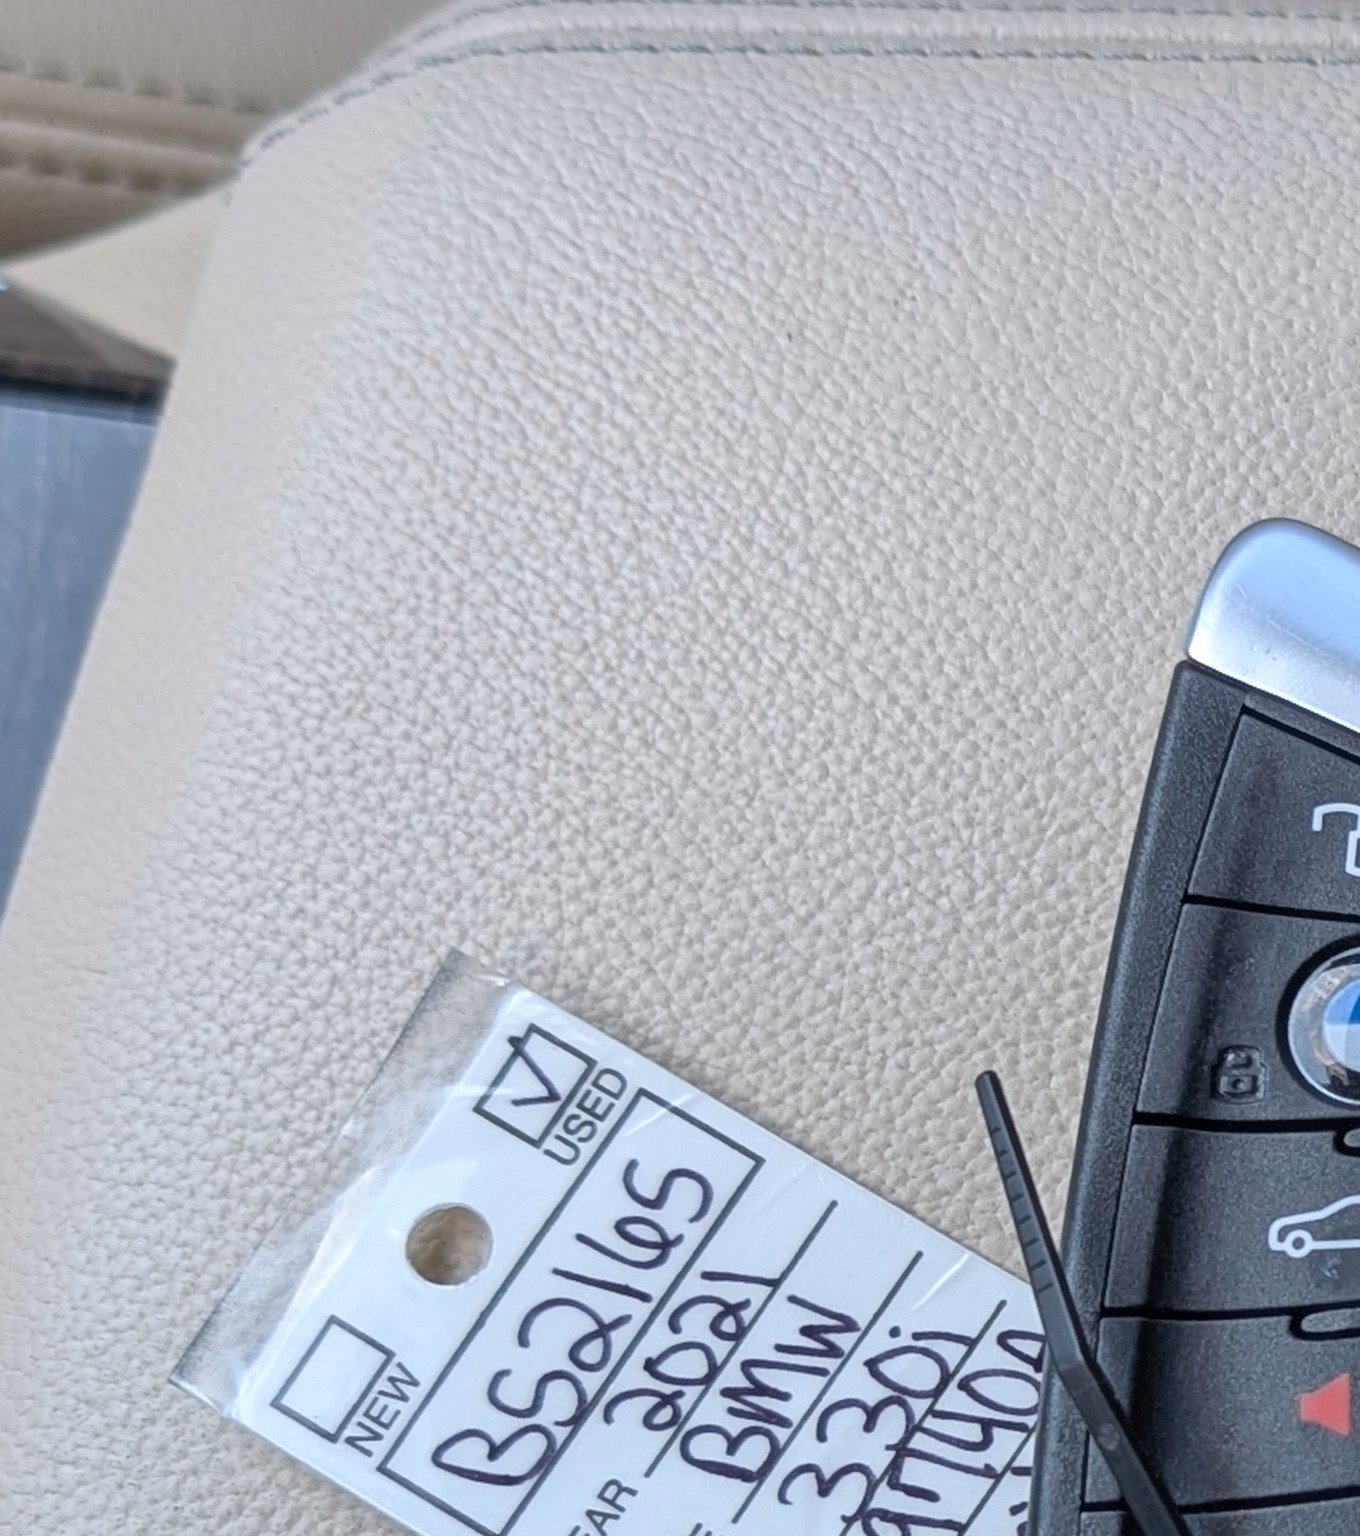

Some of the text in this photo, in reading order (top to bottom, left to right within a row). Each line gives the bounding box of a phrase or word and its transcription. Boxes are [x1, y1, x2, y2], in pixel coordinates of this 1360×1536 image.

[544, 1067, 628, 1167] USED
[345, 1361, 421, 1459] NEW
[603, 1270, 780, 1432] 2021
[679, 1294, 861, 1484] BMW
[777, 1325, 977, 1523] 330i
